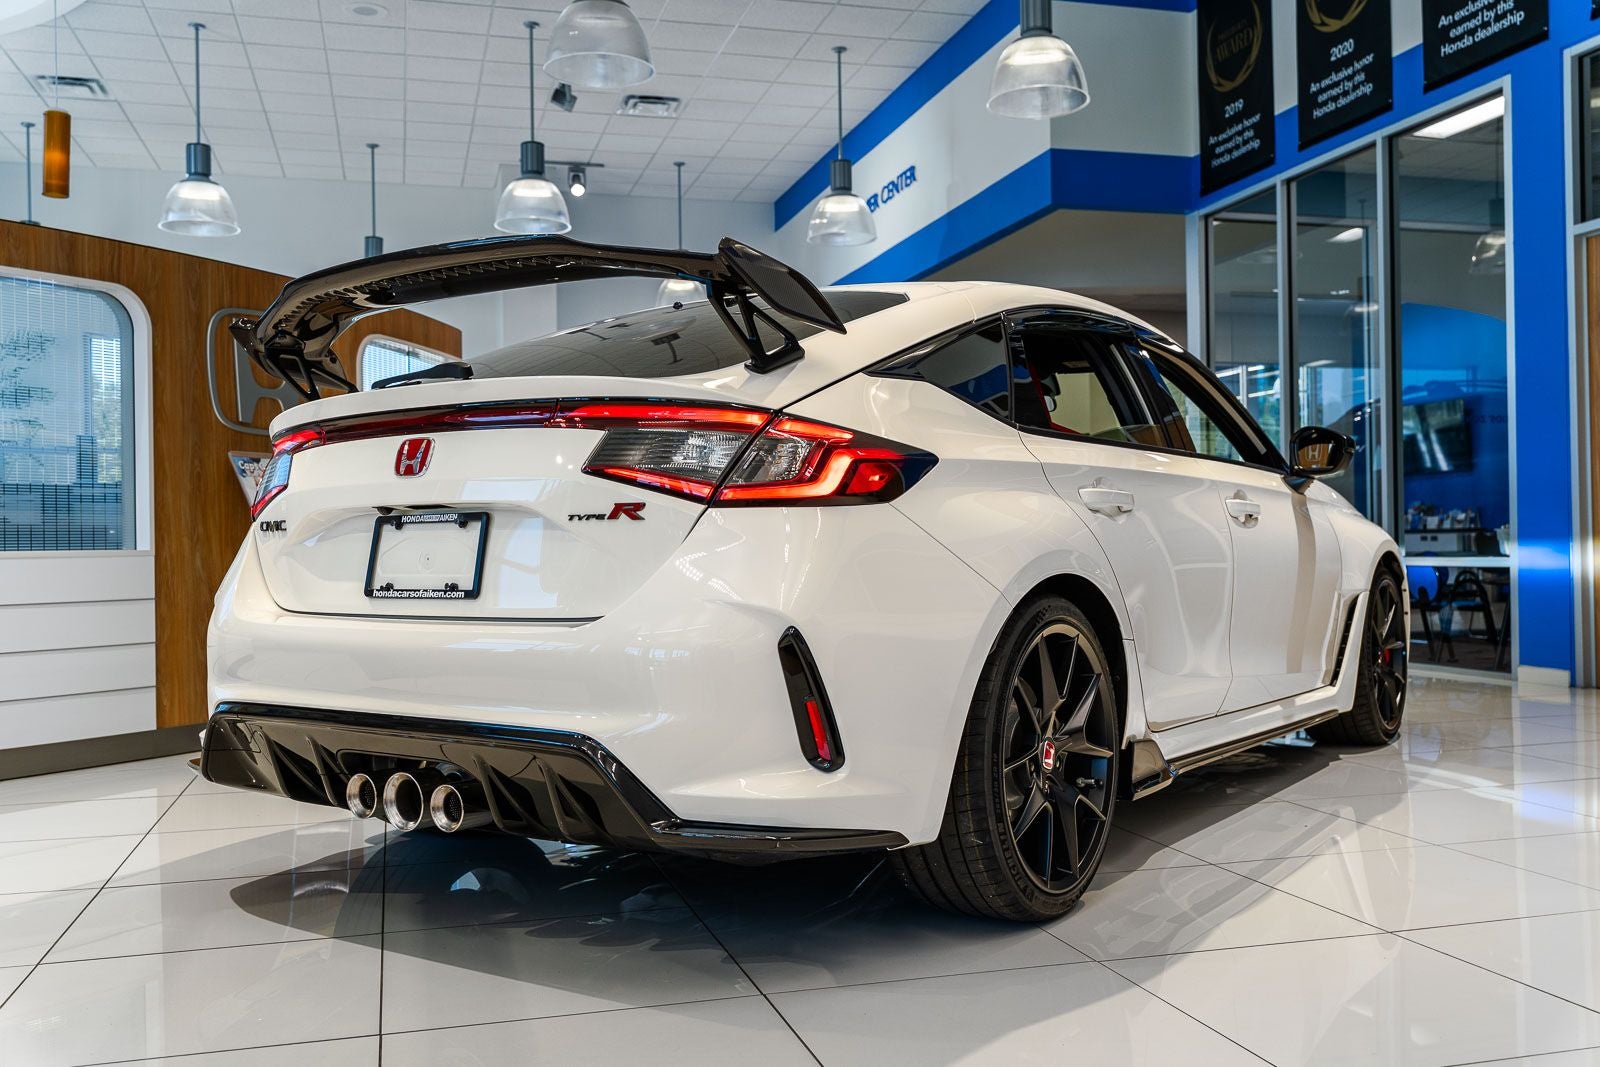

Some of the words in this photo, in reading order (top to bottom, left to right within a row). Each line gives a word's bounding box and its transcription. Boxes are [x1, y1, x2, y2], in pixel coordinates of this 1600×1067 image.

[1438, 15, 1453, 28] An
[1440, 34, 1473, 57] Honda
[1474, 10, 1525, 42] dealership
[1449, 11, 1482, 38] earned
[1483, 9, 1496, 23] by
[1497, 0, 1514, 14] this
[1330, 38, 1354, 62] 2020
[1310, 82, 1320, 94] An
[1320, 66, 1353, 88] exclusive
[1353, 53, 1374, 72] honor
[1317, 81, 1344, 103] earned
[1344, 80, 1353, 94] by
[1354, 71, 1365, 85] this
[1224, 98, 1244, 118] 2019
[1312, 100, 1336, 119] Honda
[1336, 82, 1373, 108] dealership
[1208, 135, 1218, 146] An
[1218, 123, 1243, 142] exclusive
[1242, 113, 1261, 129] honor
[1211, 153, 1230, 168] Honda
[1231, 138, 1260, 159] dealership
[1215, 136, 1236, 154] earned
[866, 193, 880, 213] ER
[881, 165, 917, 203] CENTER
[401, 515, 425, 523] HONDA
[567, 513, 607, 521] TYPE
[606, 501, 647, 521] R
[260, 520, 287, 533] CIVIC
[372, 588, 465, 599] hondacarsofaiken.com
[996, 822, 1027, 889] MICHELIN
